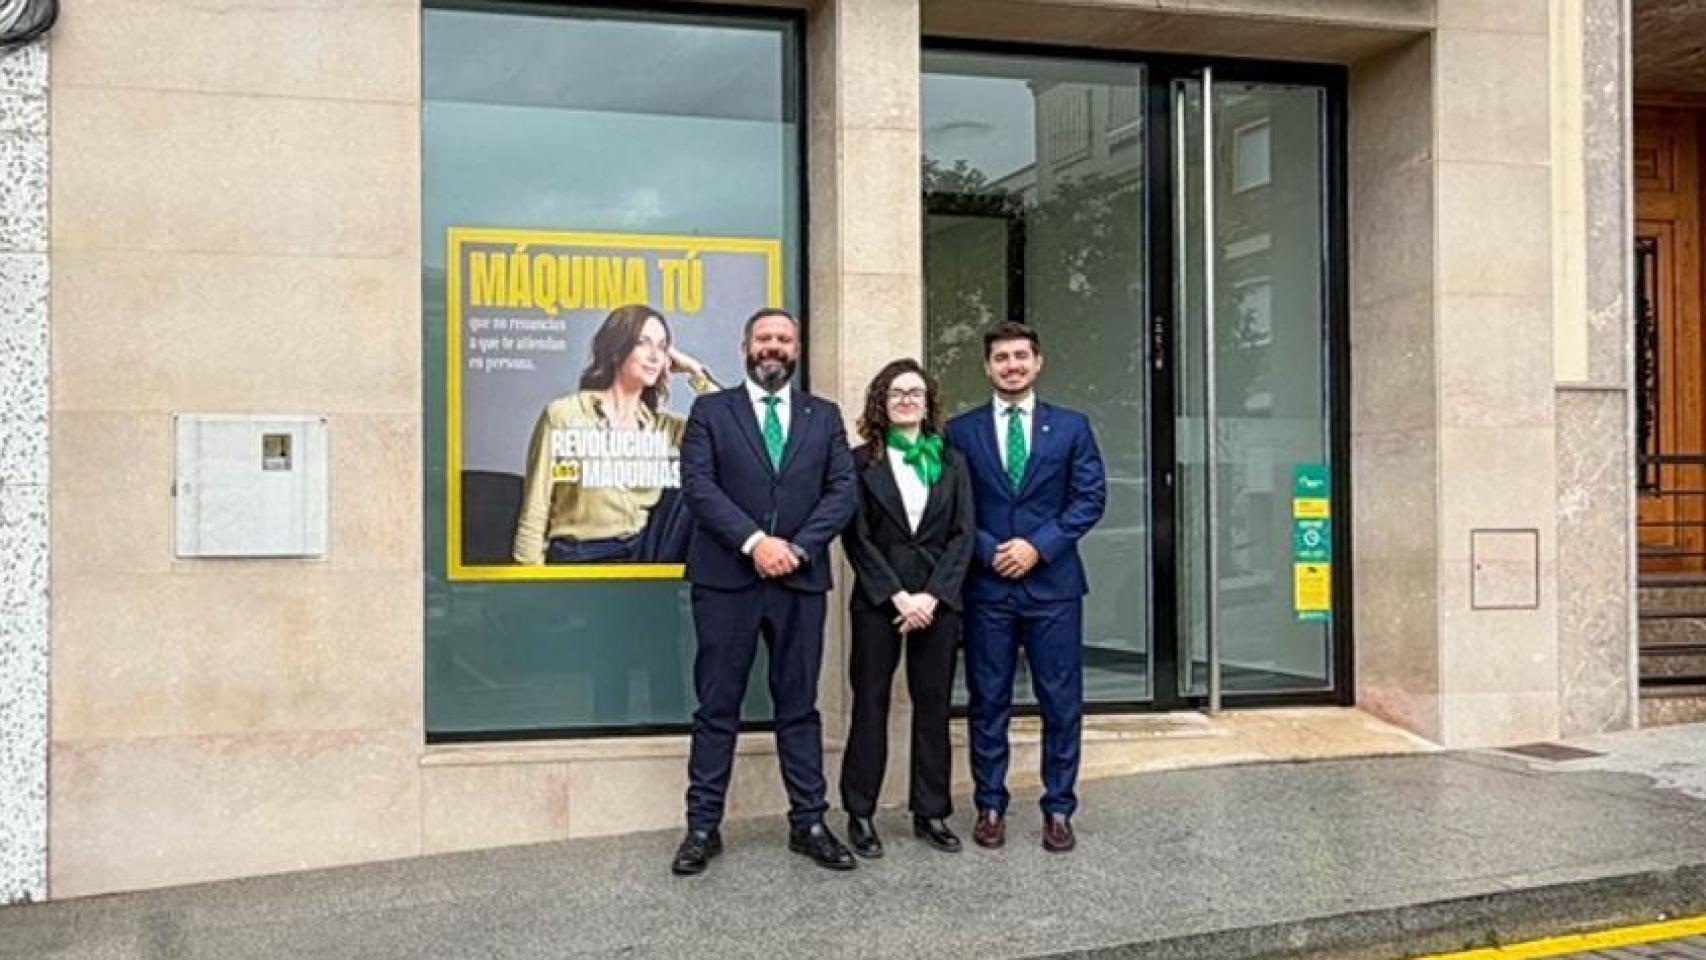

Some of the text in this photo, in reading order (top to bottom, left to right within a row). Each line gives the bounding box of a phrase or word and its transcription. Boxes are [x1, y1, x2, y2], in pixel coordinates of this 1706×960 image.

[469, 243, 704, 314] MÁQUINA TÚ
[469, 317, 491, 333] que
